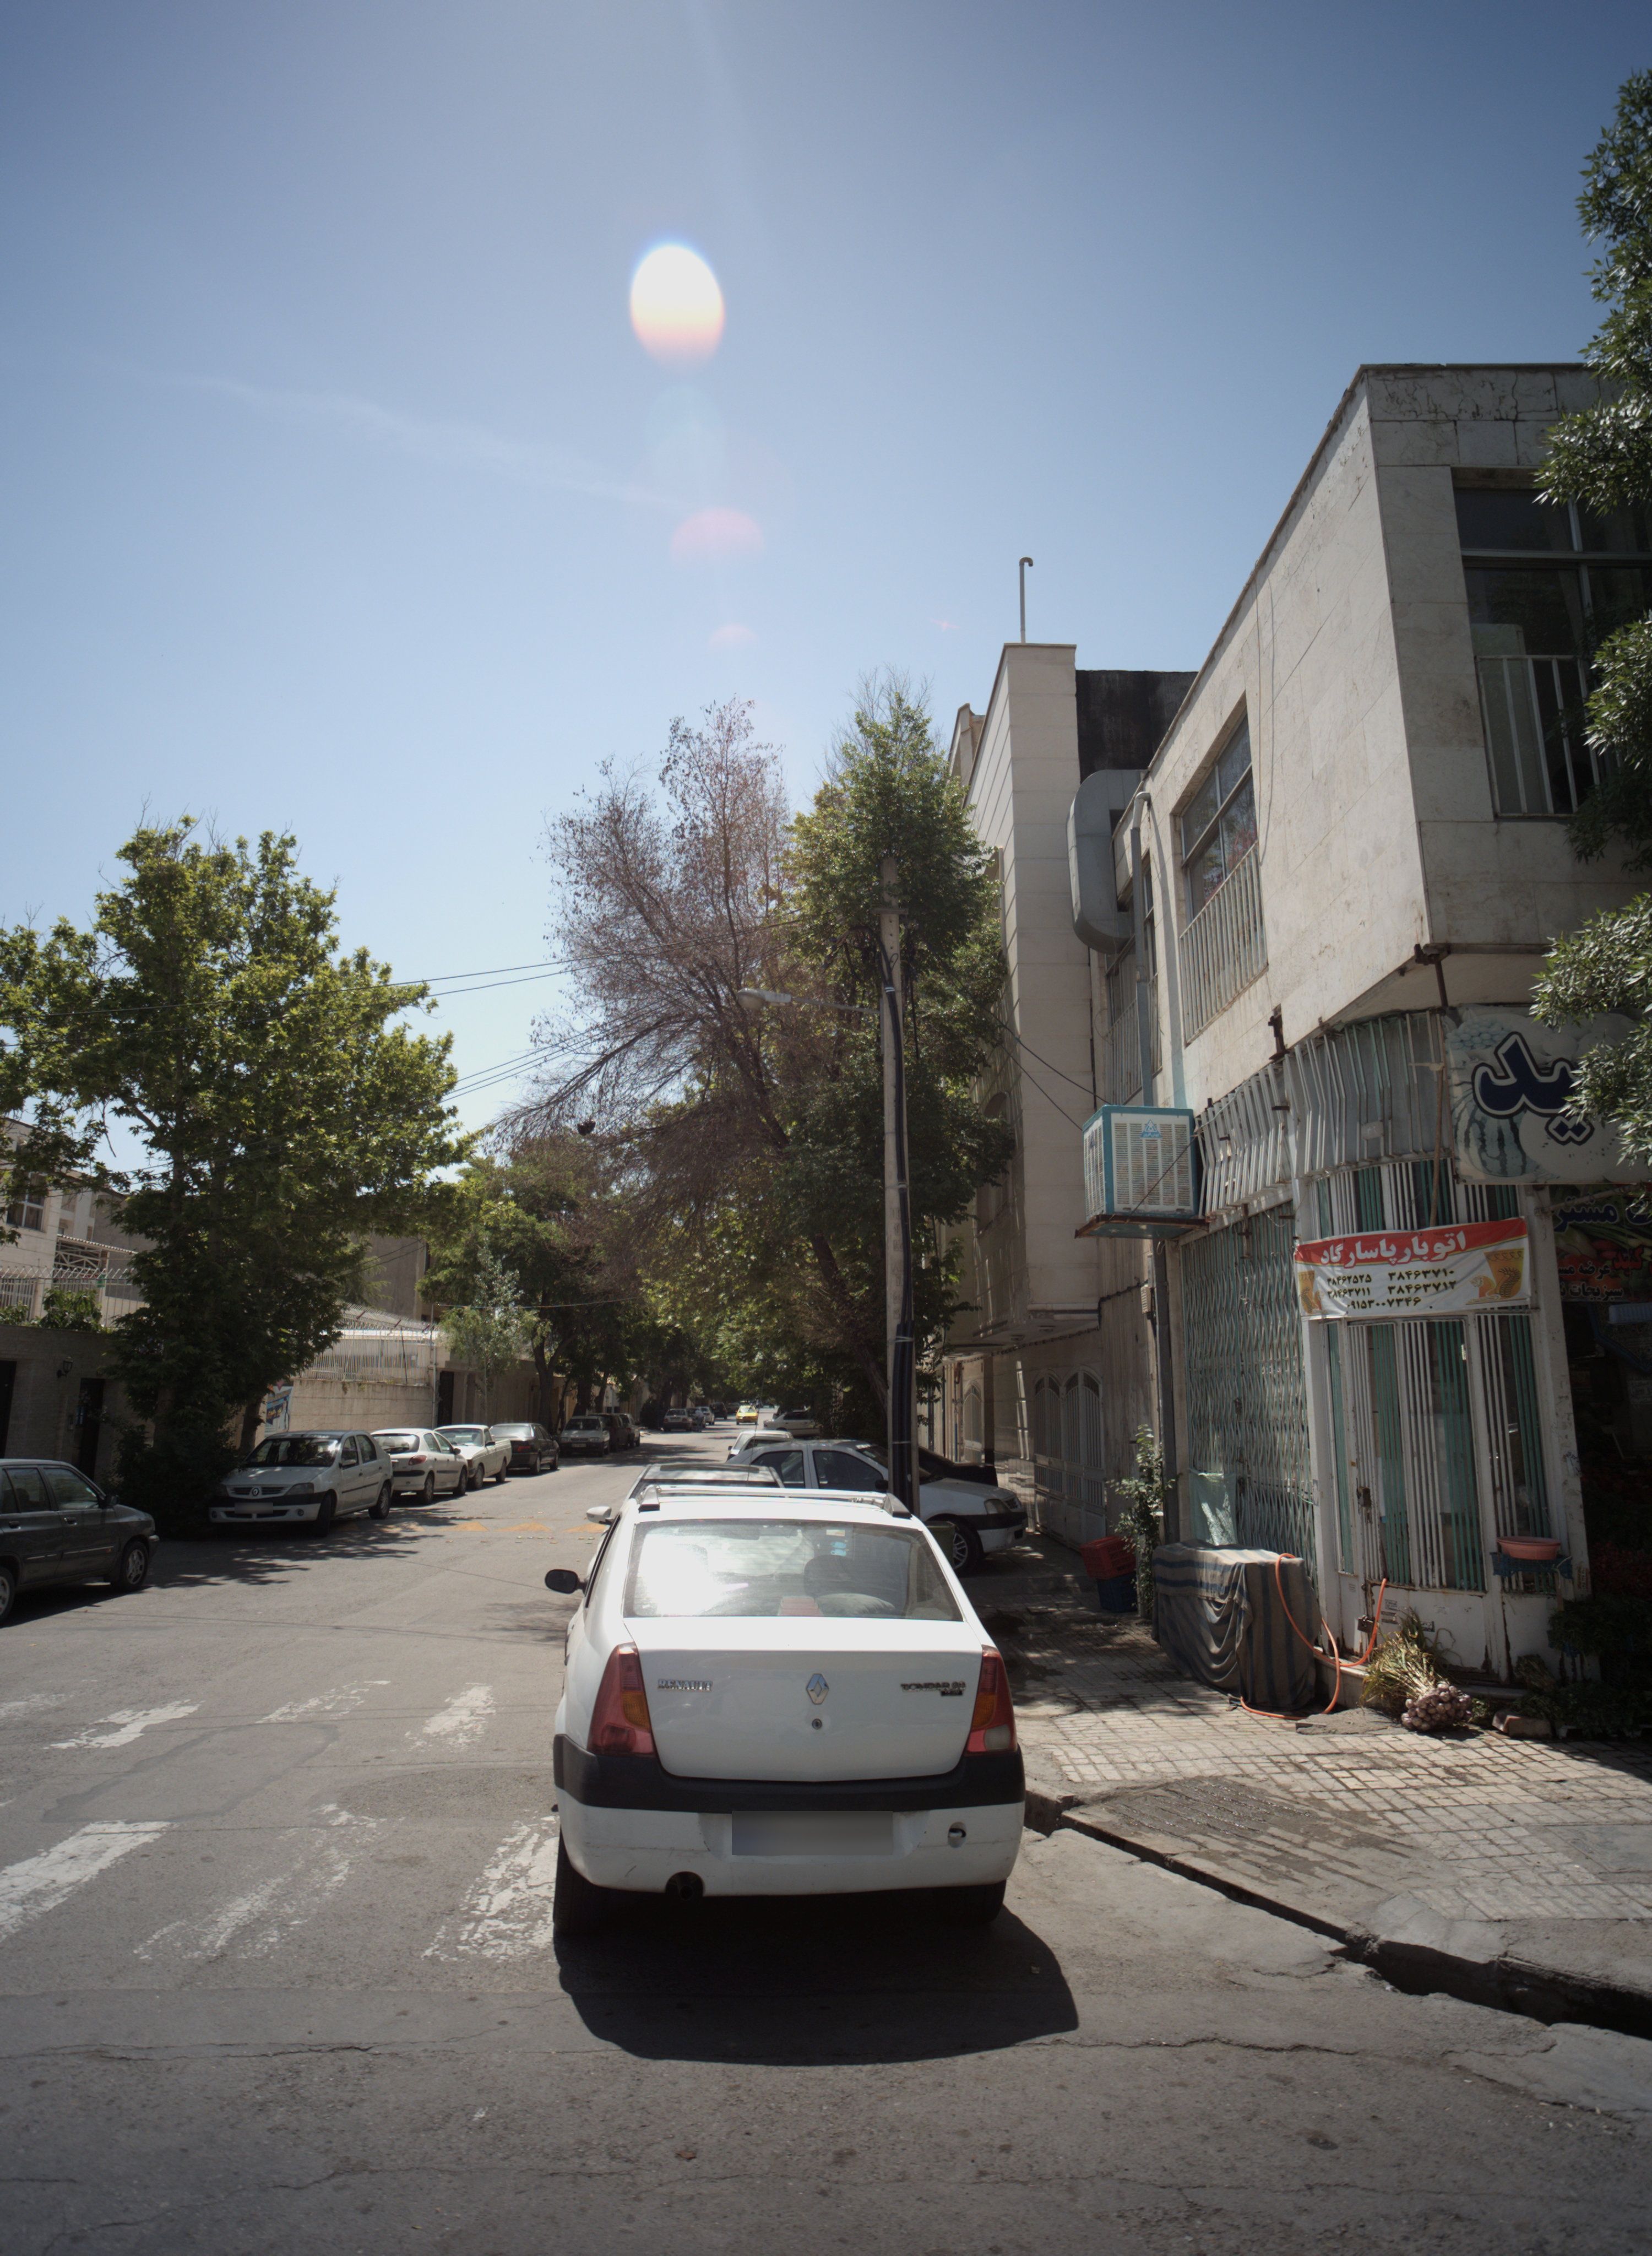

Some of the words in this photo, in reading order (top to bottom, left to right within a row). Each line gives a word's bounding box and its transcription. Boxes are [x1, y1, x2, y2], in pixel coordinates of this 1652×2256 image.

[1553, 1194, 1618, 1234] مشتر
[1320, 1238, 1396, 1267] پاسارگاد
[1397, 1230, 1466, 1263] اتوبار
[1388, 1268, 1454, 1281] ۳۸۴۶۳۷۱۰
[1347, 1297, 1421, 1310] ۰۹۱۵۳۰۰۷۳۴۶
[657, 1679, 713, 1692] RENAULT
